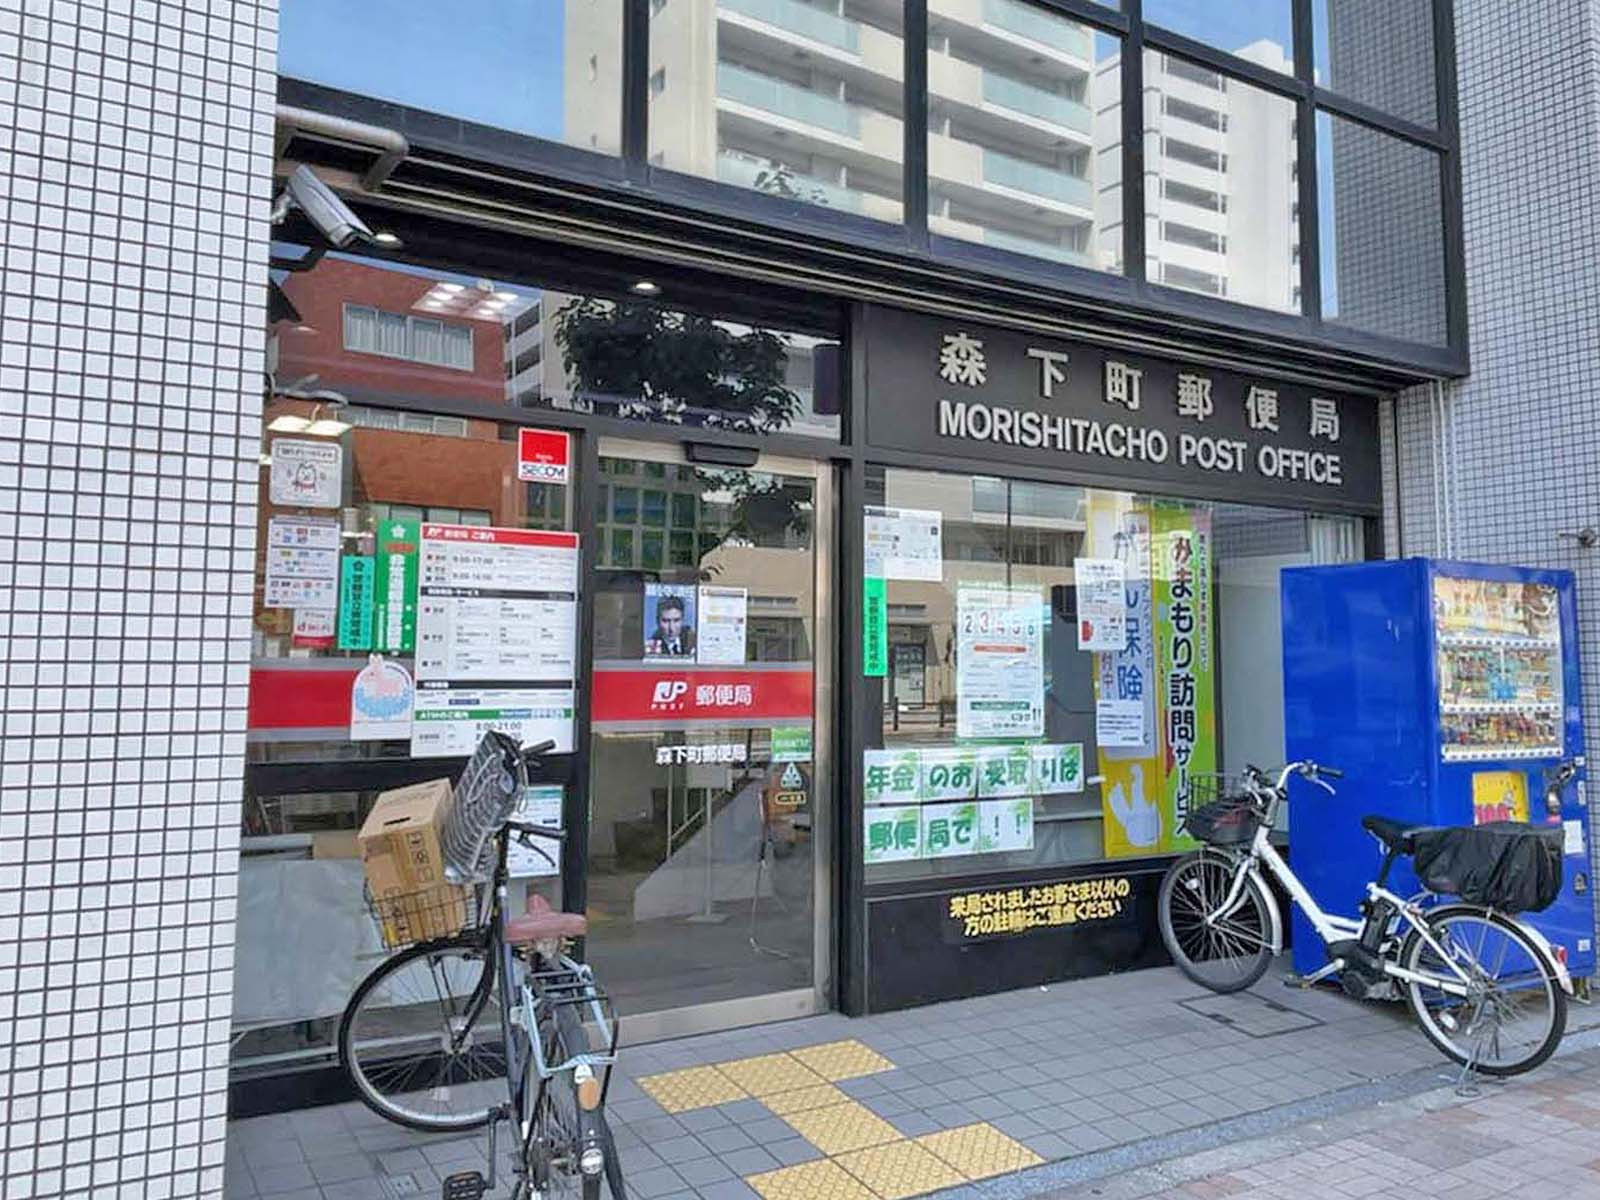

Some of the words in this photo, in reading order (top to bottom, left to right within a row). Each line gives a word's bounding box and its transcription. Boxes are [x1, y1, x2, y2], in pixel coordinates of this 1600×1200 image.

[939, 332, 1340, 442] 森下町郵便局
[938, 400, 1169, 464] MORISHITACHO
[1179, 433, 1247, 473] POST
[1257, 444, 1343, 486] OFFICE
[695, 684, 753, 707] 郵便局
[655, 743, 747, 765] 森下町郵便局
[867, 757, 1079, 793] 年金のお受取りは
[950, 878, 1130, 918] 来局されましたお客さま以外の
